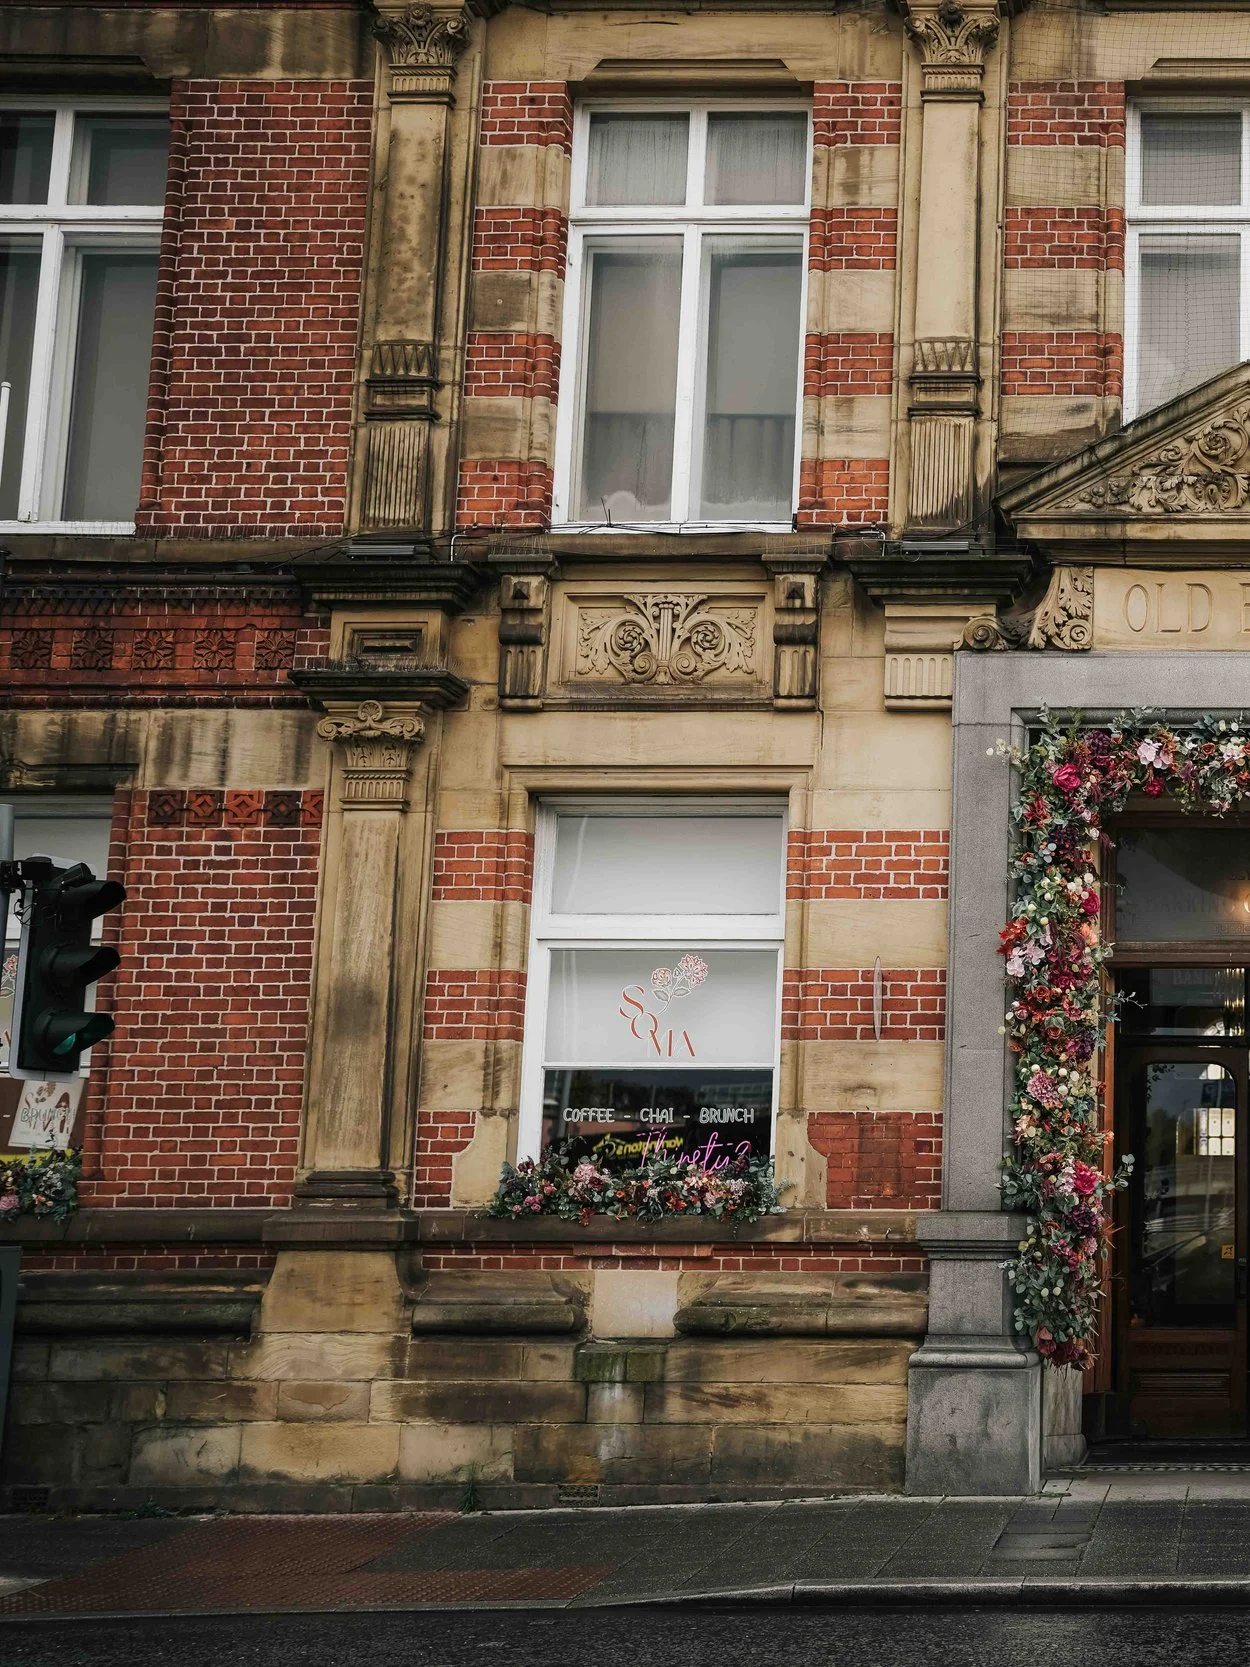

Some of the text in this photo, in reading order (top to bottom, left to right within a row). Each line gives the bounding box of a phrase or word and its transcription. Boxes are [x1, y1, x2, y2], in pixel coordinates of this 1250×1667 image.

[1123, 582, 1213, 632] OLD
[562, 1107, 755, 1124] COFFEE CHAI BRUNCH
